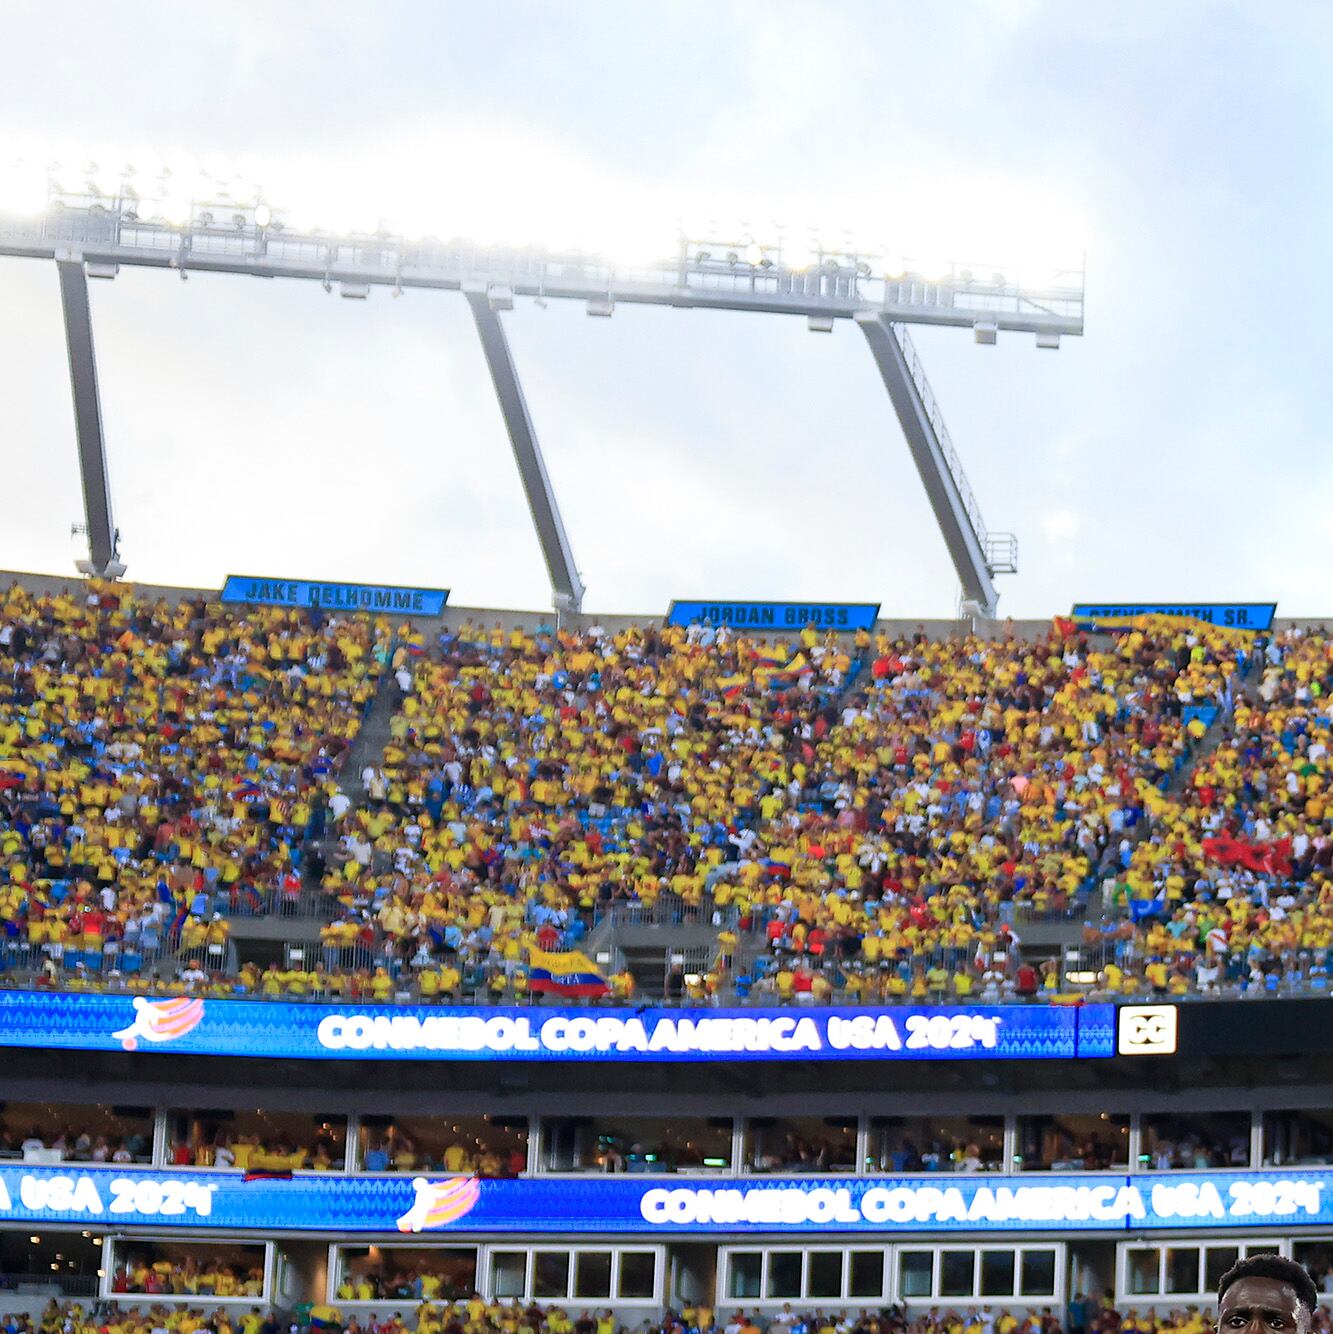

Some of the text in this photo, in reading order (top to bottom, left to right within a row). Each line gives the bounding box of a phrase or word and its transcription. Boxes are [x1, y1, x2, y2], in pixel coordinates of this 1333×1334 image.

[245, 582, 298, 602] JAKE
[318, 1015, 996, 1051] CONMEBOL COPA AMERICA USA 2024
[20, 1175, 103, 1214] USA
[110, 1178, 213, 1216] 2024
[641, 1180, 1320, 1223] CONMEBOL COPA AMERICA USA 2024
